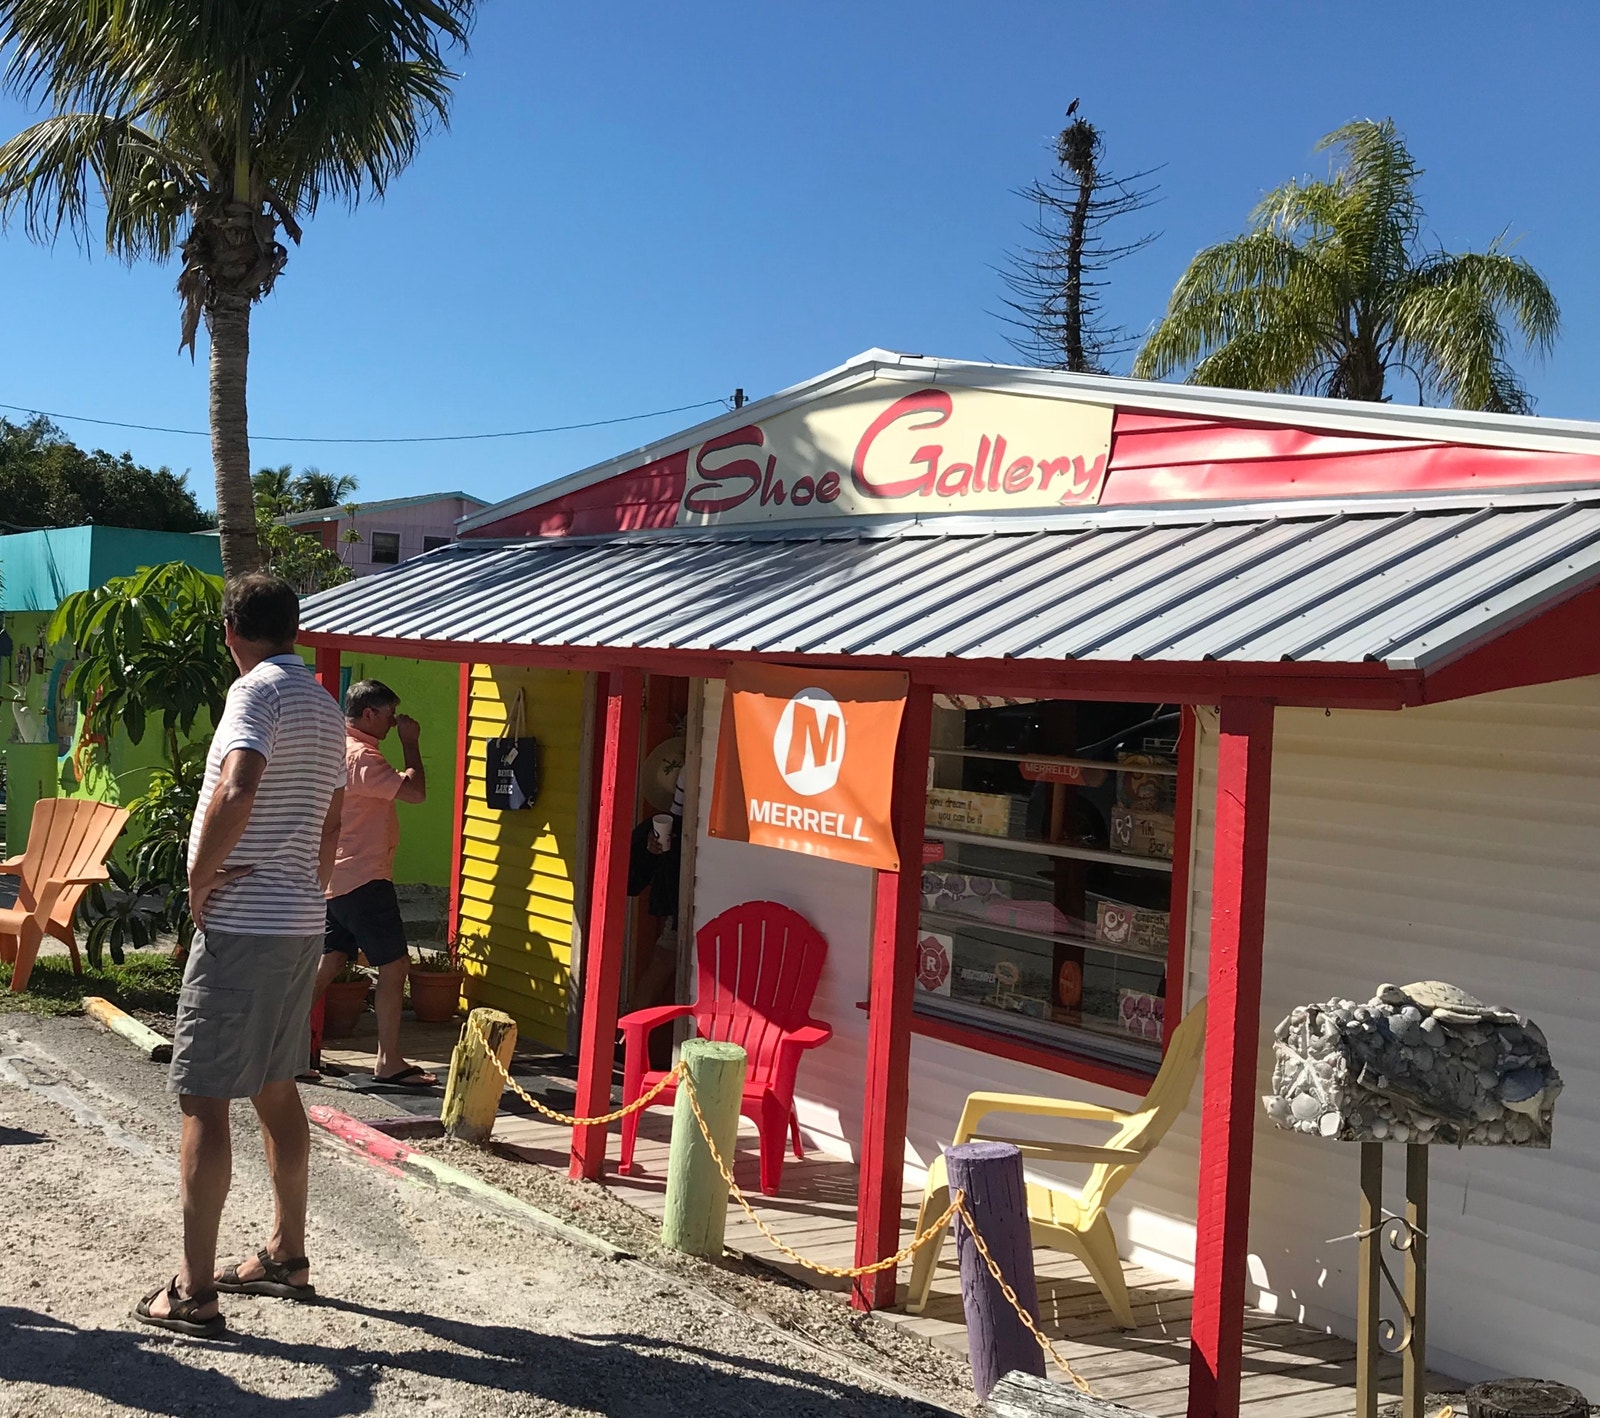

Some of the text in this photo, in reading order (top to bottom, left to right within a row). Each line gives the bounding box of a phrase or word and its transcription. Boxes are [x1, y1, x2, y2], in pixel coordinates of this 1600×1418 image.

[684, 388, 1107, 514] Shoe Gallery
[785, 701, 840, 775] M
[1025, 762, 1069, 775] MERRELL
[929, 798, 943, 809] you
[945, 797, 967, 810] dream
[750, 799, 870, 842] MERRELL
[937, 812, 951, 825] you
[953, 813, 966, 822] can
[966, 811, 976, 824] be
[926, 955, 937, 972] R
